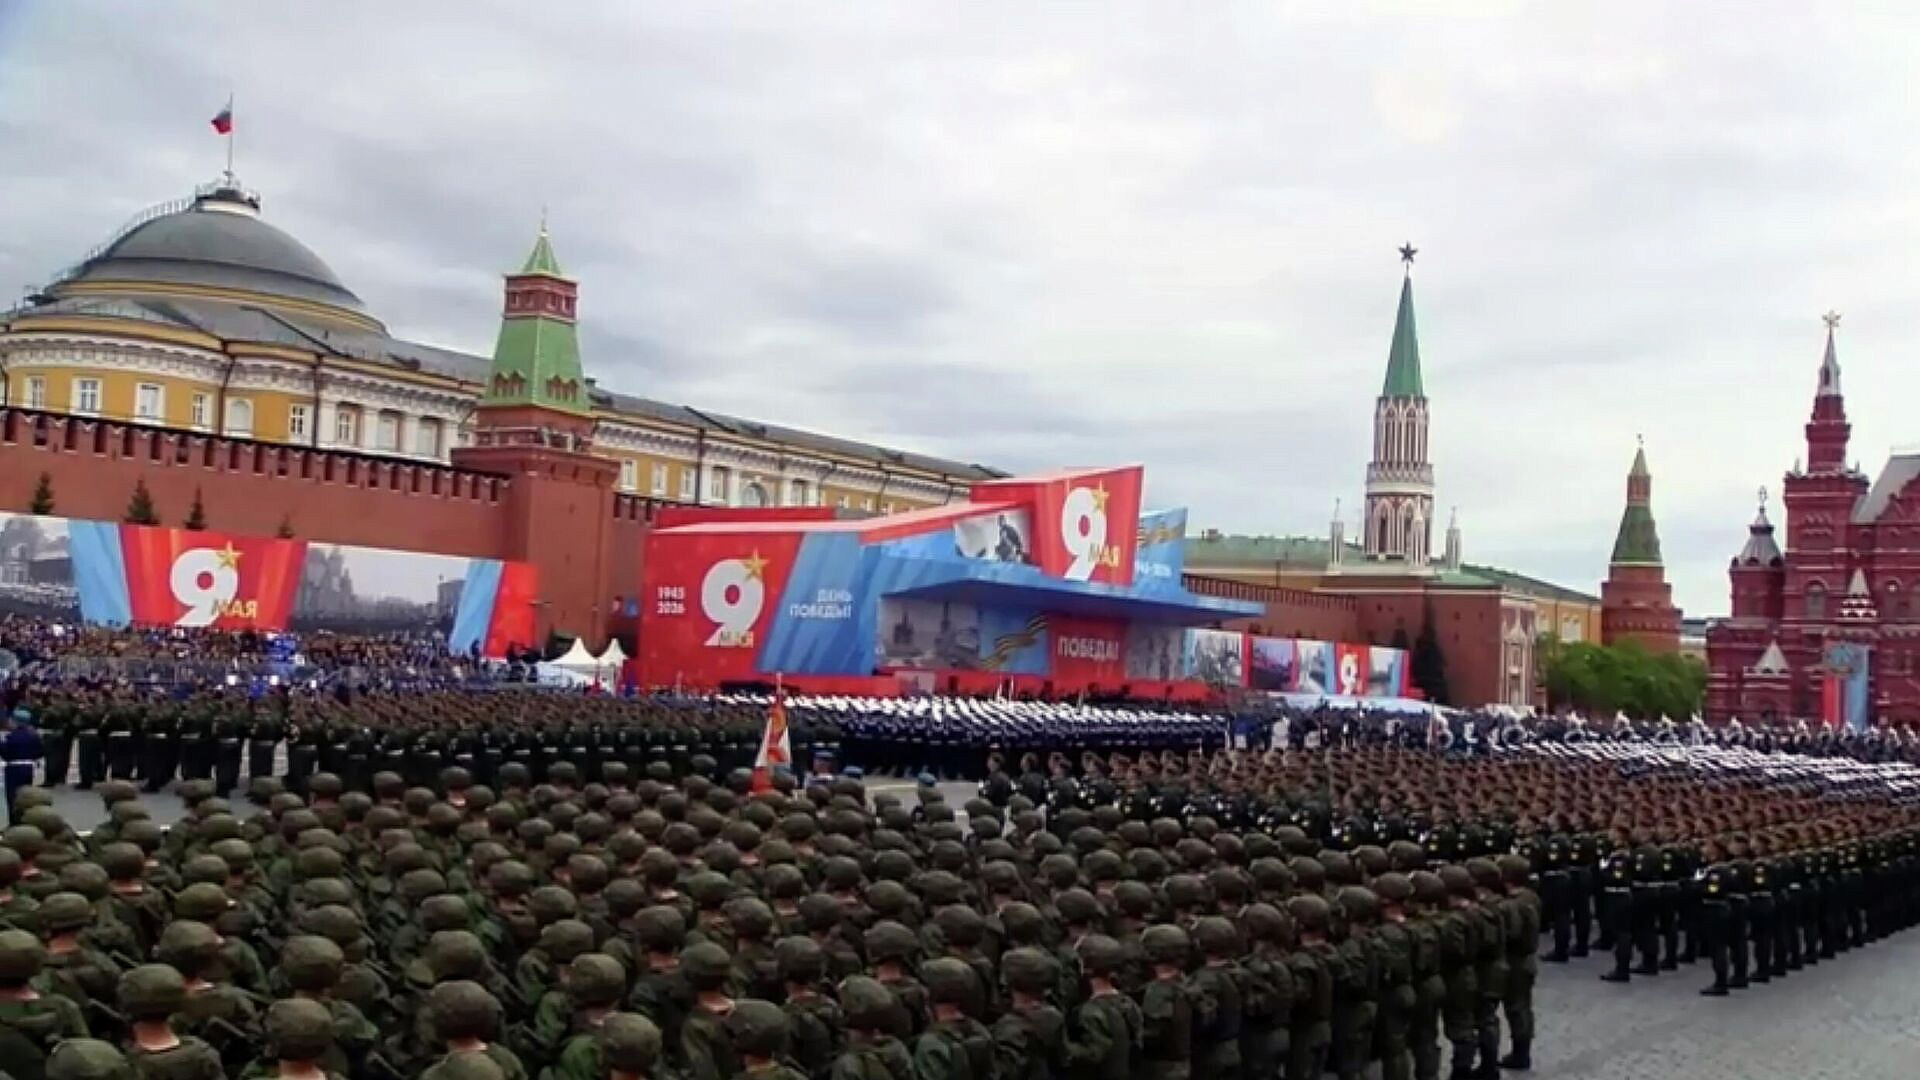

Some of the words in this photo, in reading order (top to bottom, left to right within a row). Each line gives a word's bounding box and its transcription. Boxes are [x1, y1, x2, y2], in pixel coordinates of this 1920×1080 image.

[1061, 486, 1107, 580] 9
[170, 548, 239, 626] 9
[211, 599, 257, 618] МАЯ
[702, 559, 764, 646] 9
